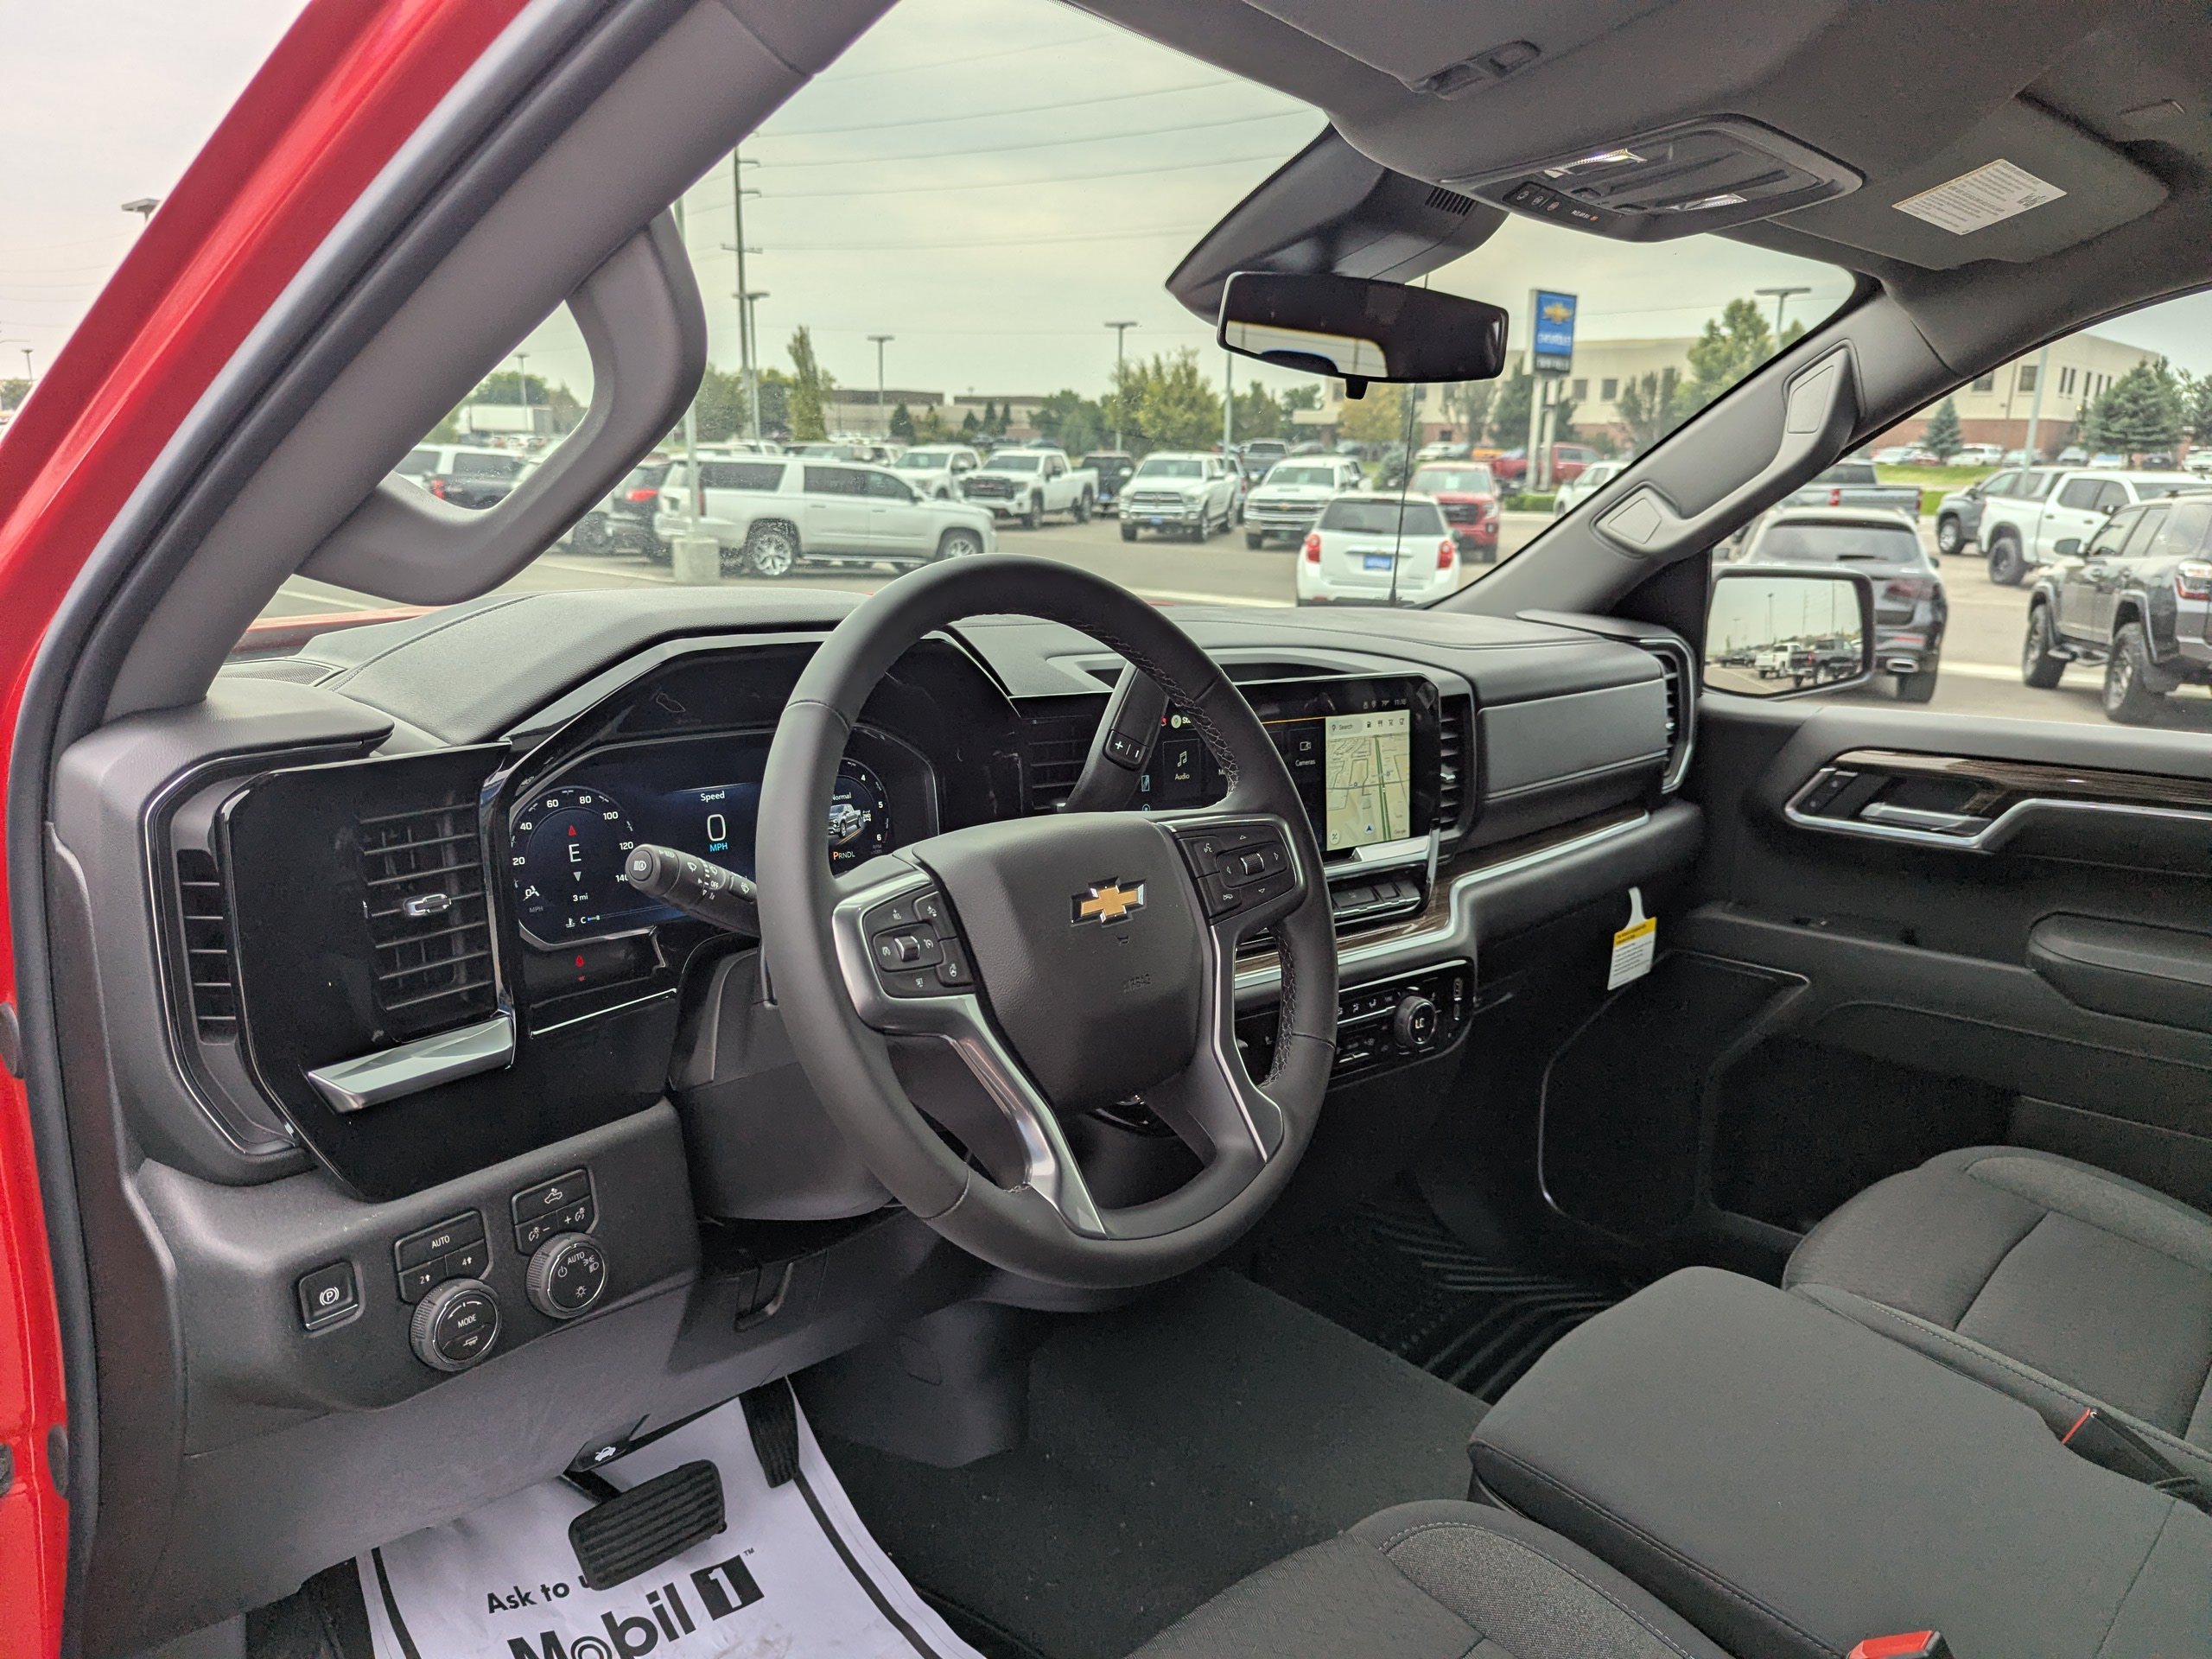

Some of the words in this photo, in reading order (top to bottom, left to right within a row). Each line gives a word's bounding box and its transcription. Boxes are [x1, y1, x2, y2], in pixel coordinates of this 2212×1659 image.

[579, 795, 592, 804] 80
[701, 791, 725, 802] Speed
[546, 799, 559, 808] 60
[602, 811, 619, 821] 100
[519, 822, 533, 830] 40
[619, 841, 634, 851] 120
[709, 842, 728, 852] MPH
[569, 843, 582, 863] E
[512, 856, 525, 866] 20
[710, 880, 719, 889] OFF
[579, 893, 588, 901] mi
[431, 1235, 450, 1249] AUTO
[567, 1251, 585, 1265] AUTO
[457, 1313, 477, 1328] MODE
[486, 1586, 537, 1614] Ask
[540, 1582, 570, 1602] to
